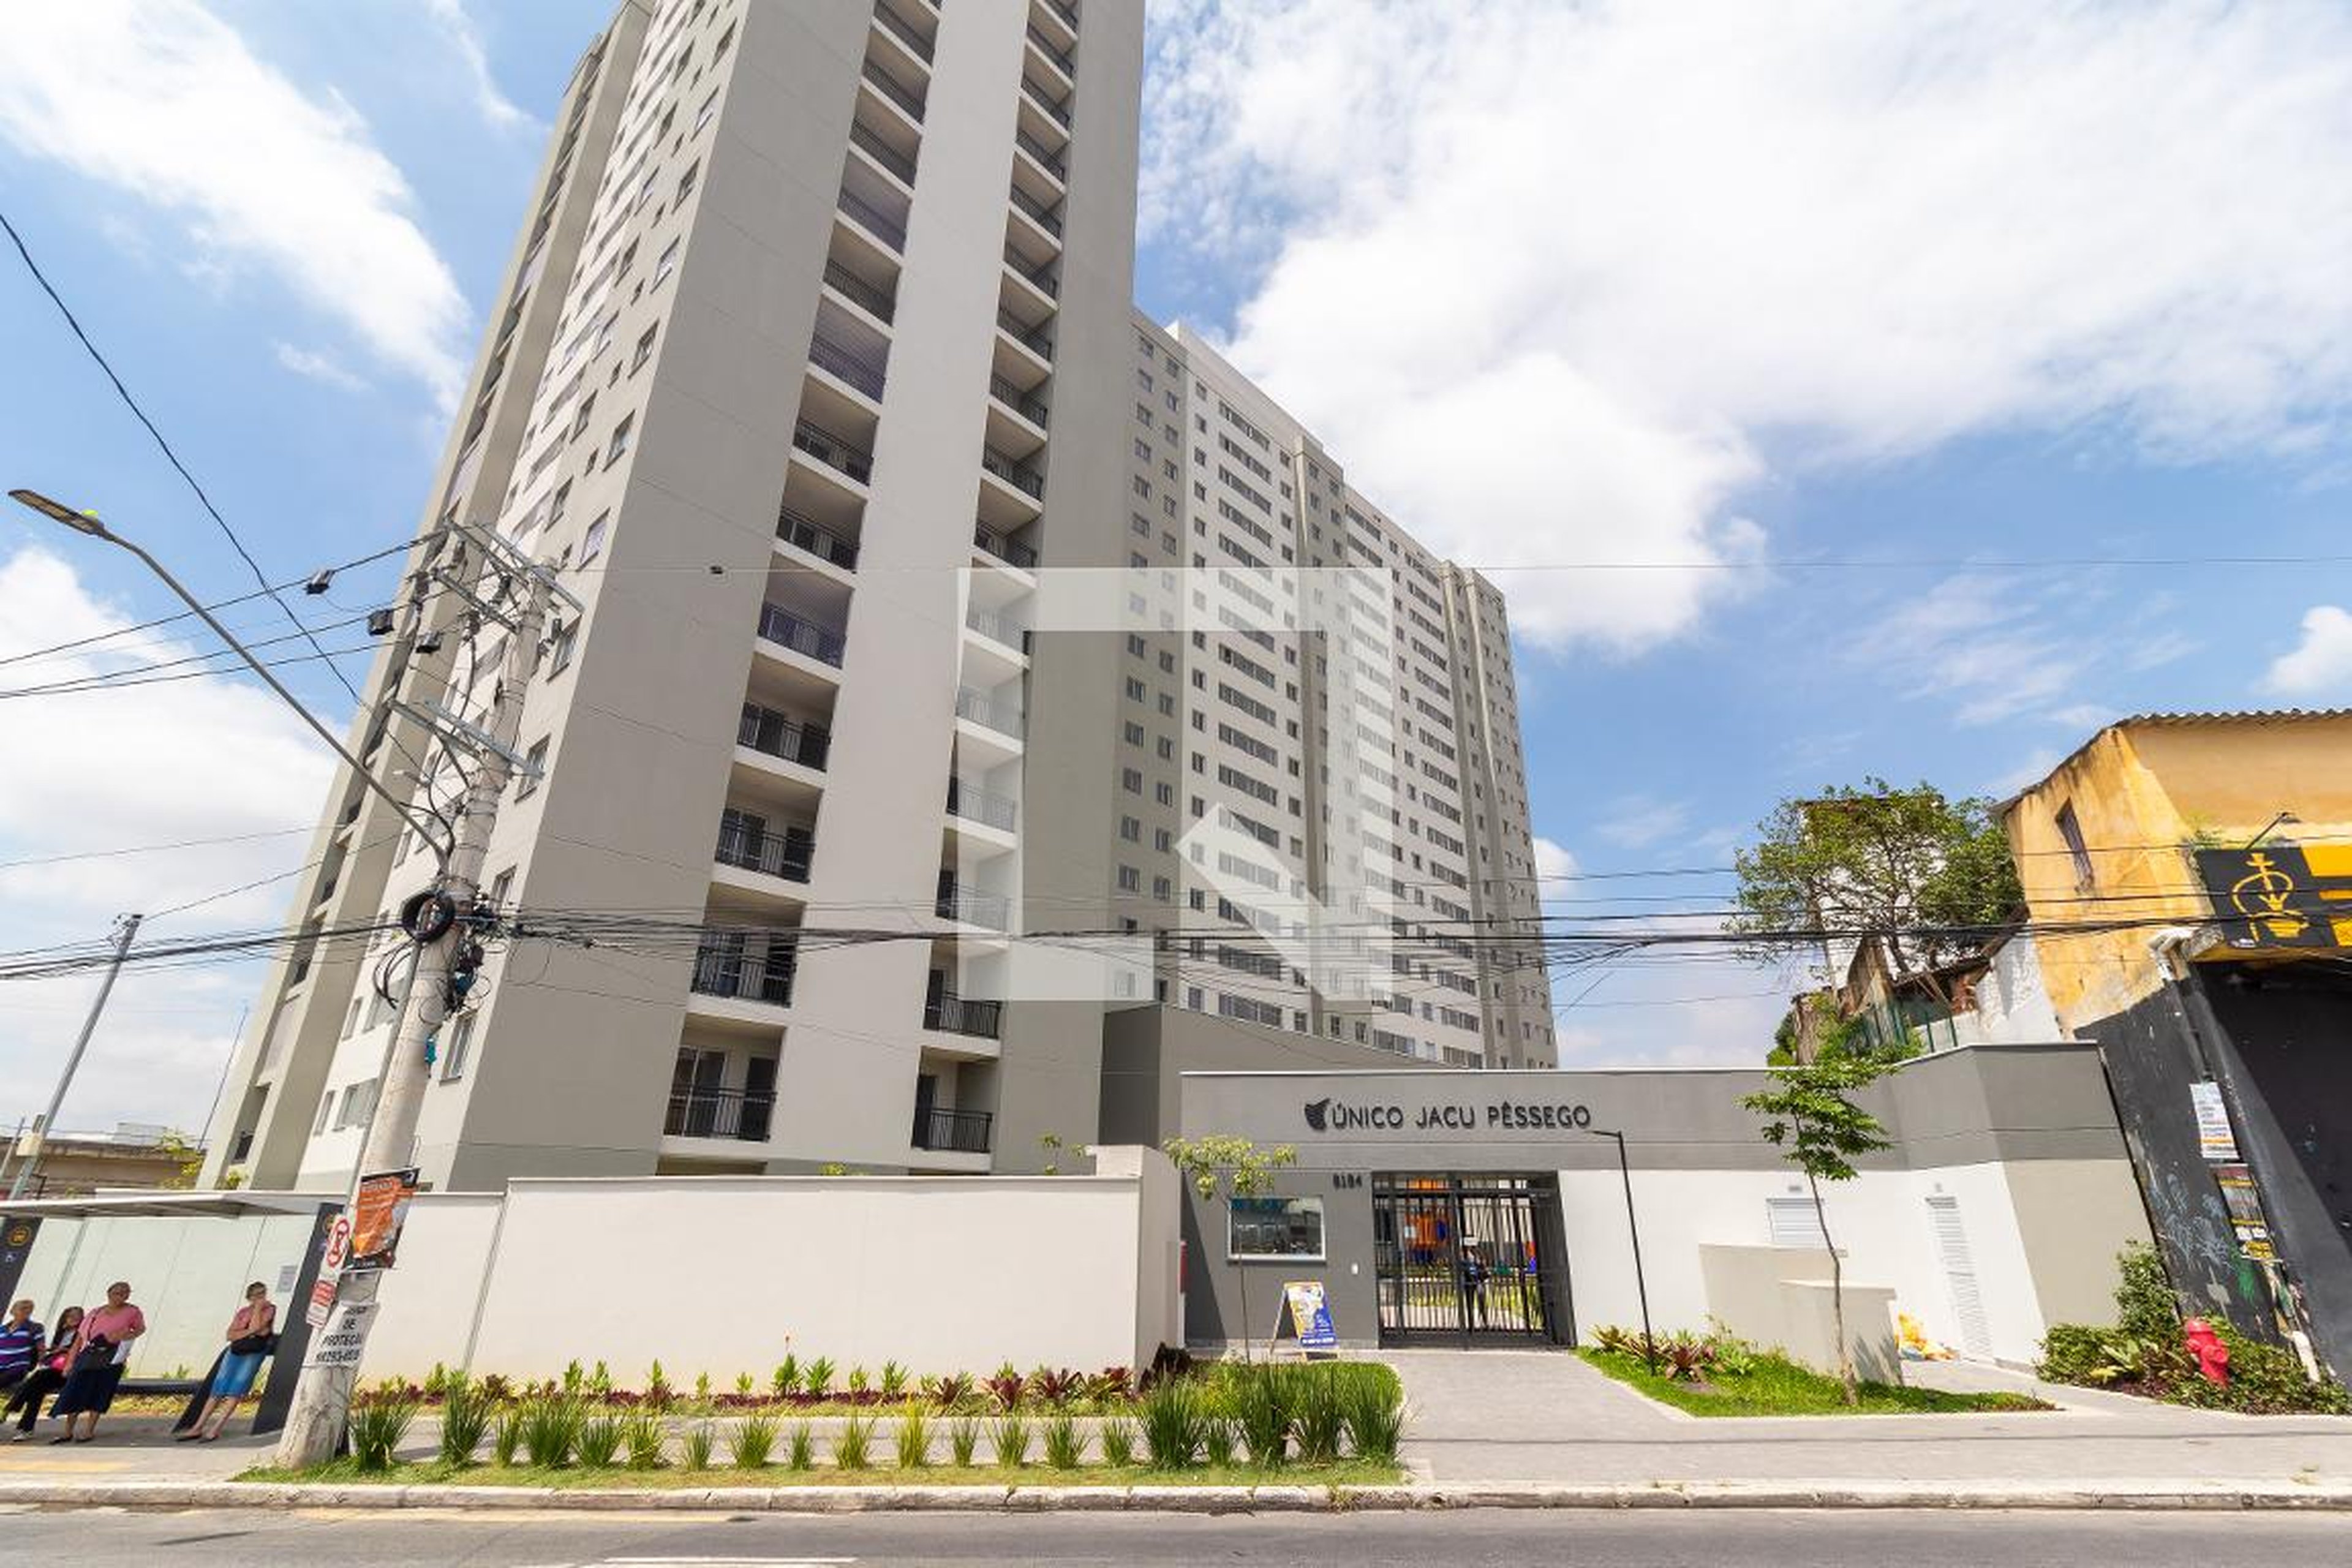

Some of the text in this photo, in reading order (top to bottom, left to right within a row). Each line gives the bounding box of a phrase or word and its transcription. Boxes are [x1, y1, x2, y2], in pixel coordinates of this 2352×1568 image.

[1333, 1101, 1591, 1129] ÚNICO JACU PÊSSEGO
